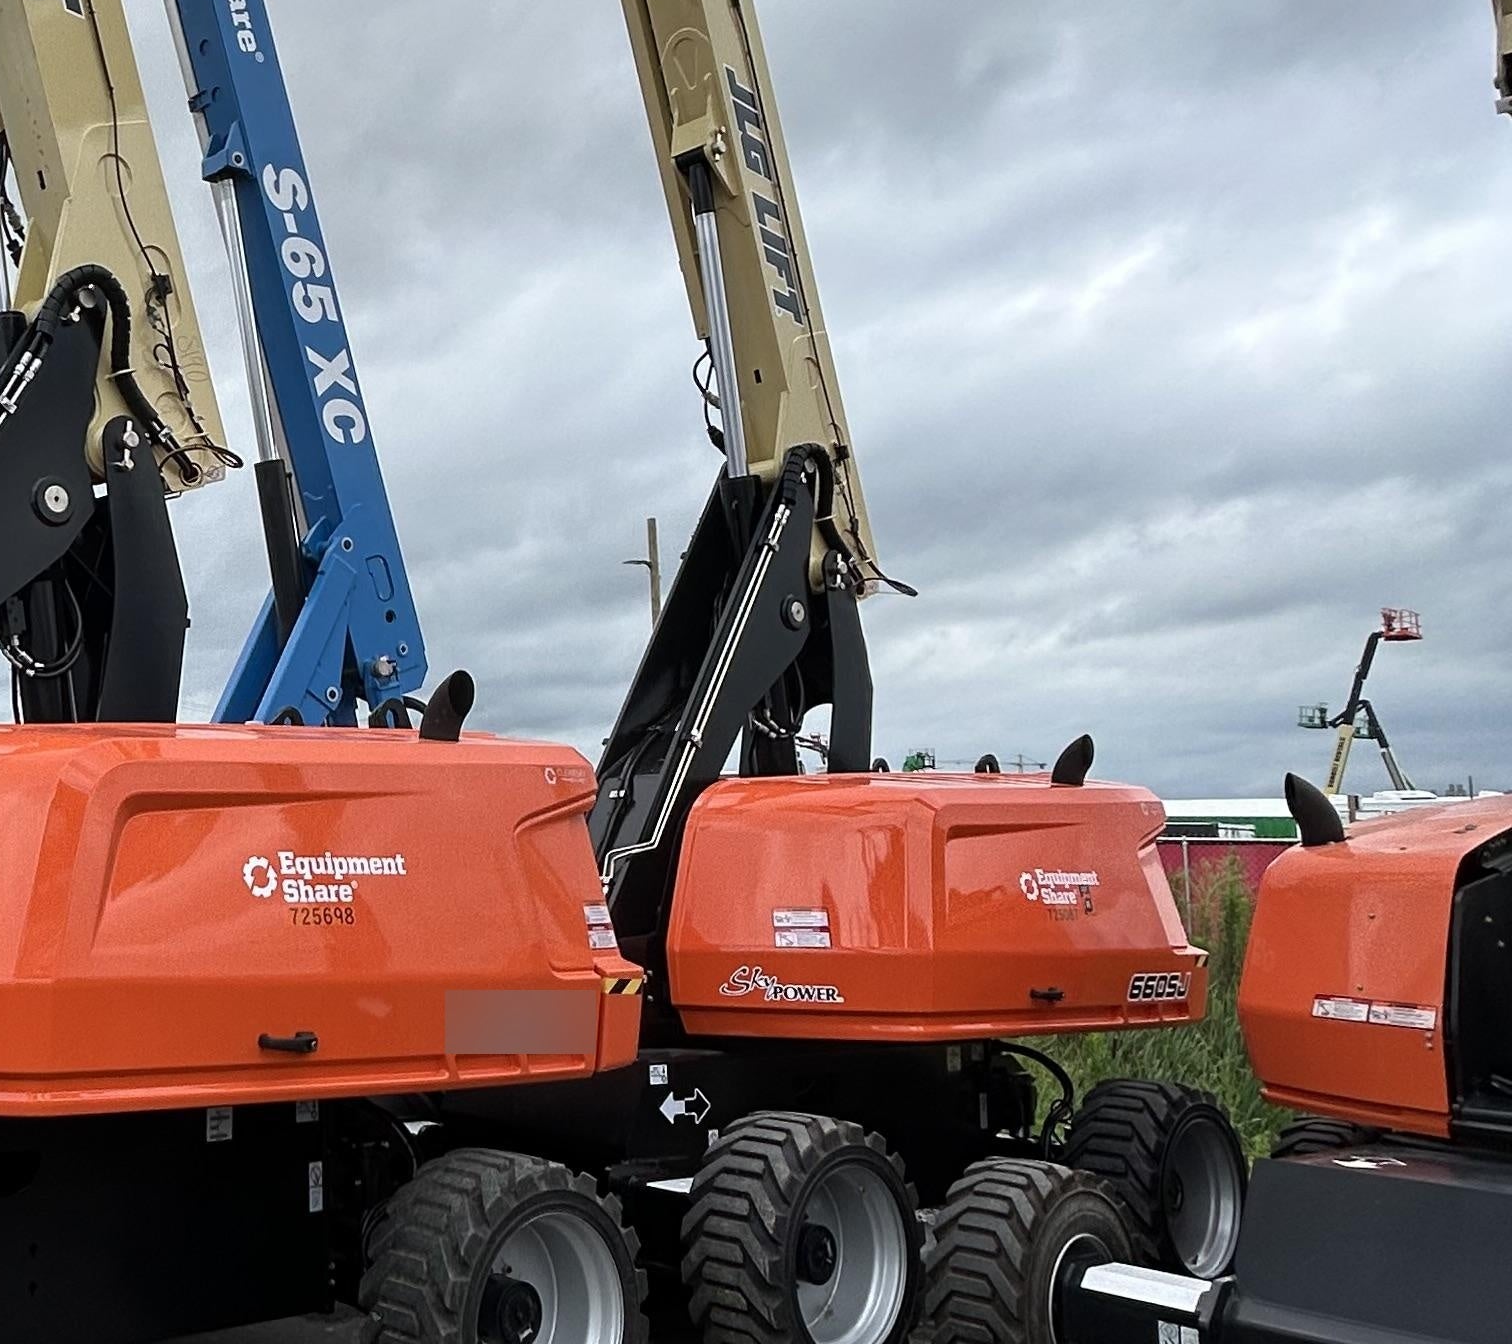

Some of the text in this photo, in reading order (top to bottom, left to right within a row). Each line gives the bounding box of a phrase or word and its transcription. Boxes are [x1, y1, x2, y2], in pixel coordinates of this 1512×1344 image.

[724, 65, 804, 327] JLG LIFT
[262, 162, 366, 446] S-65 XC
[277, 851, 407, 880] Equipment
[1034, 868, 1100, 888] Equipment
[281, 879, 354, 903] Share
[1040, 887, 1077, 905] Share
[289, 906, 355, 926] 725698
